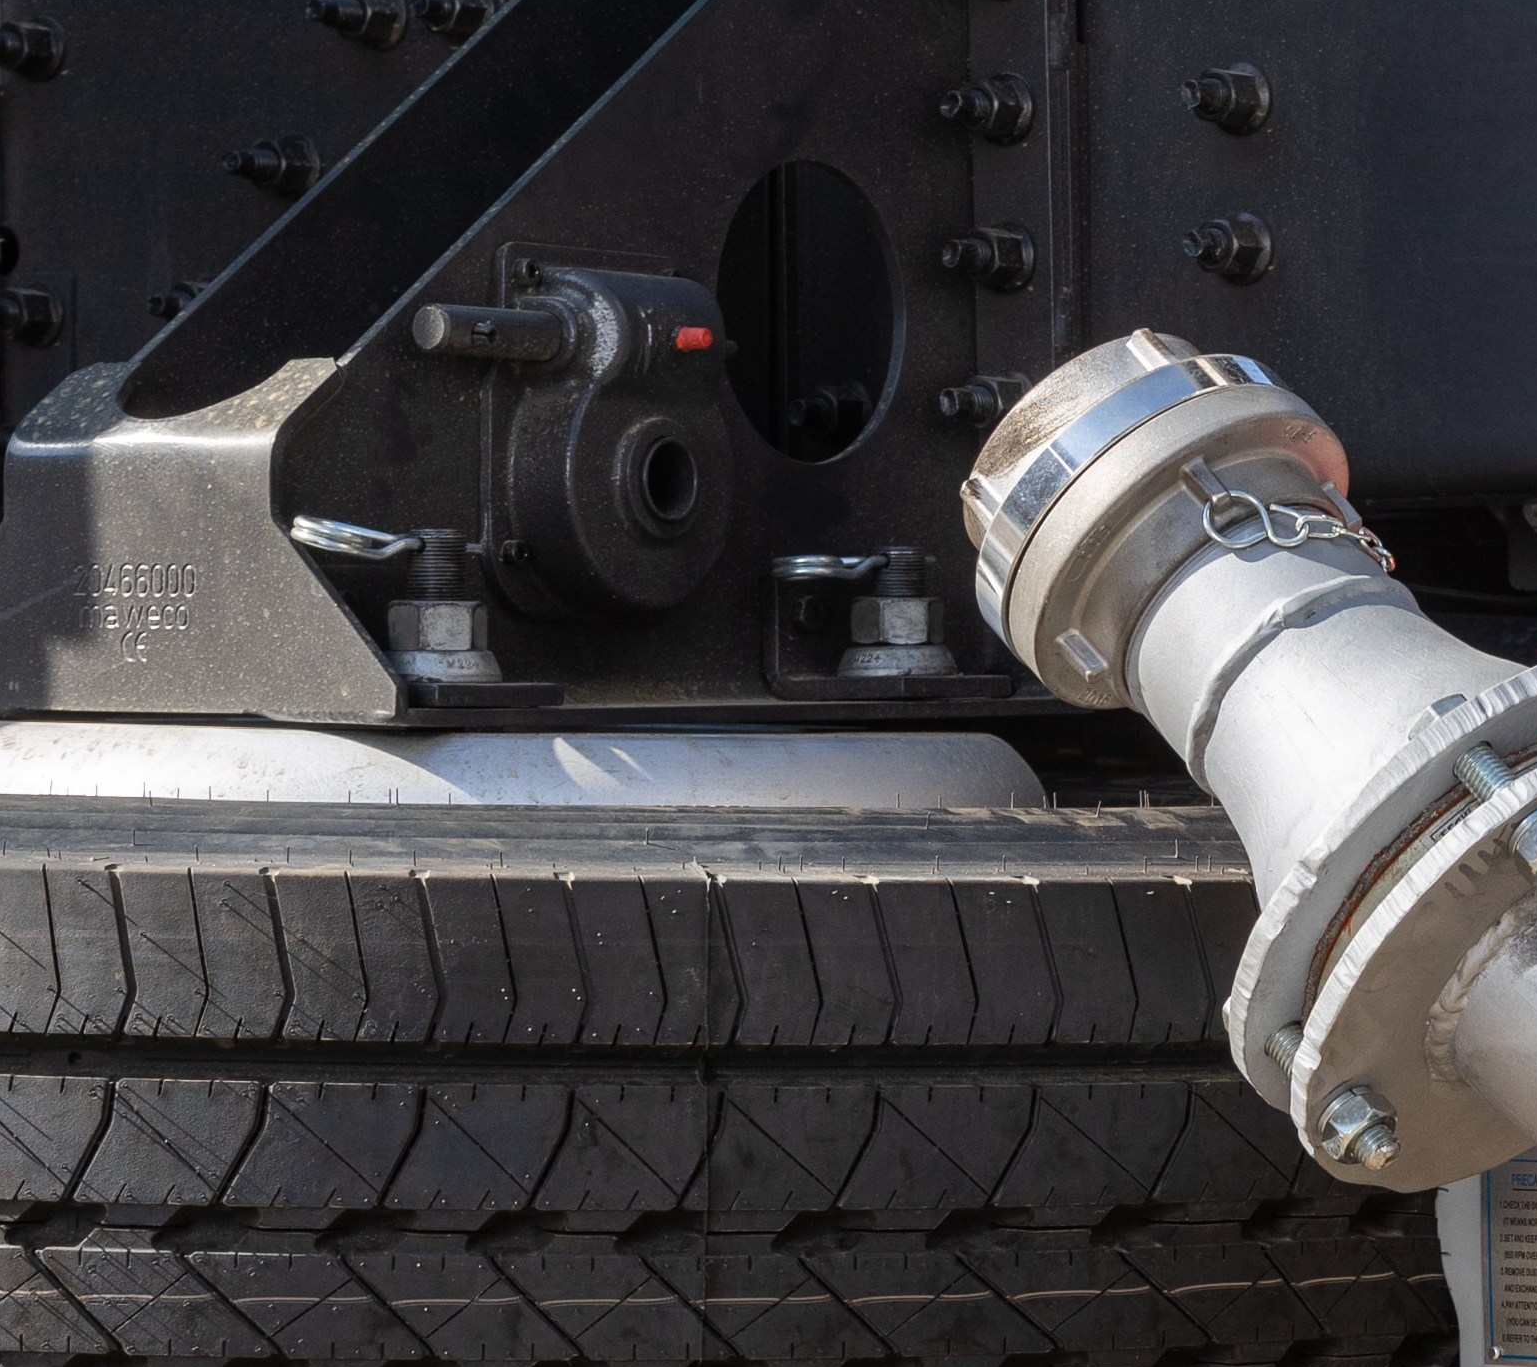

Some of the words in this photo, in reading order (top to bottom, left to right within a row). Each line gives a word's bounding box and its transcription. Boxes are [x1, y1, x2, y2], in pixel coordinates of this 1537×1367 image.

[72, 562, 197, 598] 20466000
[79, 603, 190, 630] maweco
[1509, 1216, 1527, 1227] MEANS
[1524, 1234, 1537, 1244] KEEP
[1514, 1250, 1525, 1260] RPM
[1504, 1283, 1514, 1293] AND
[1519, 1316, 1529, 1327] CAN
[1522, 1334, 1530, 1344] TO
